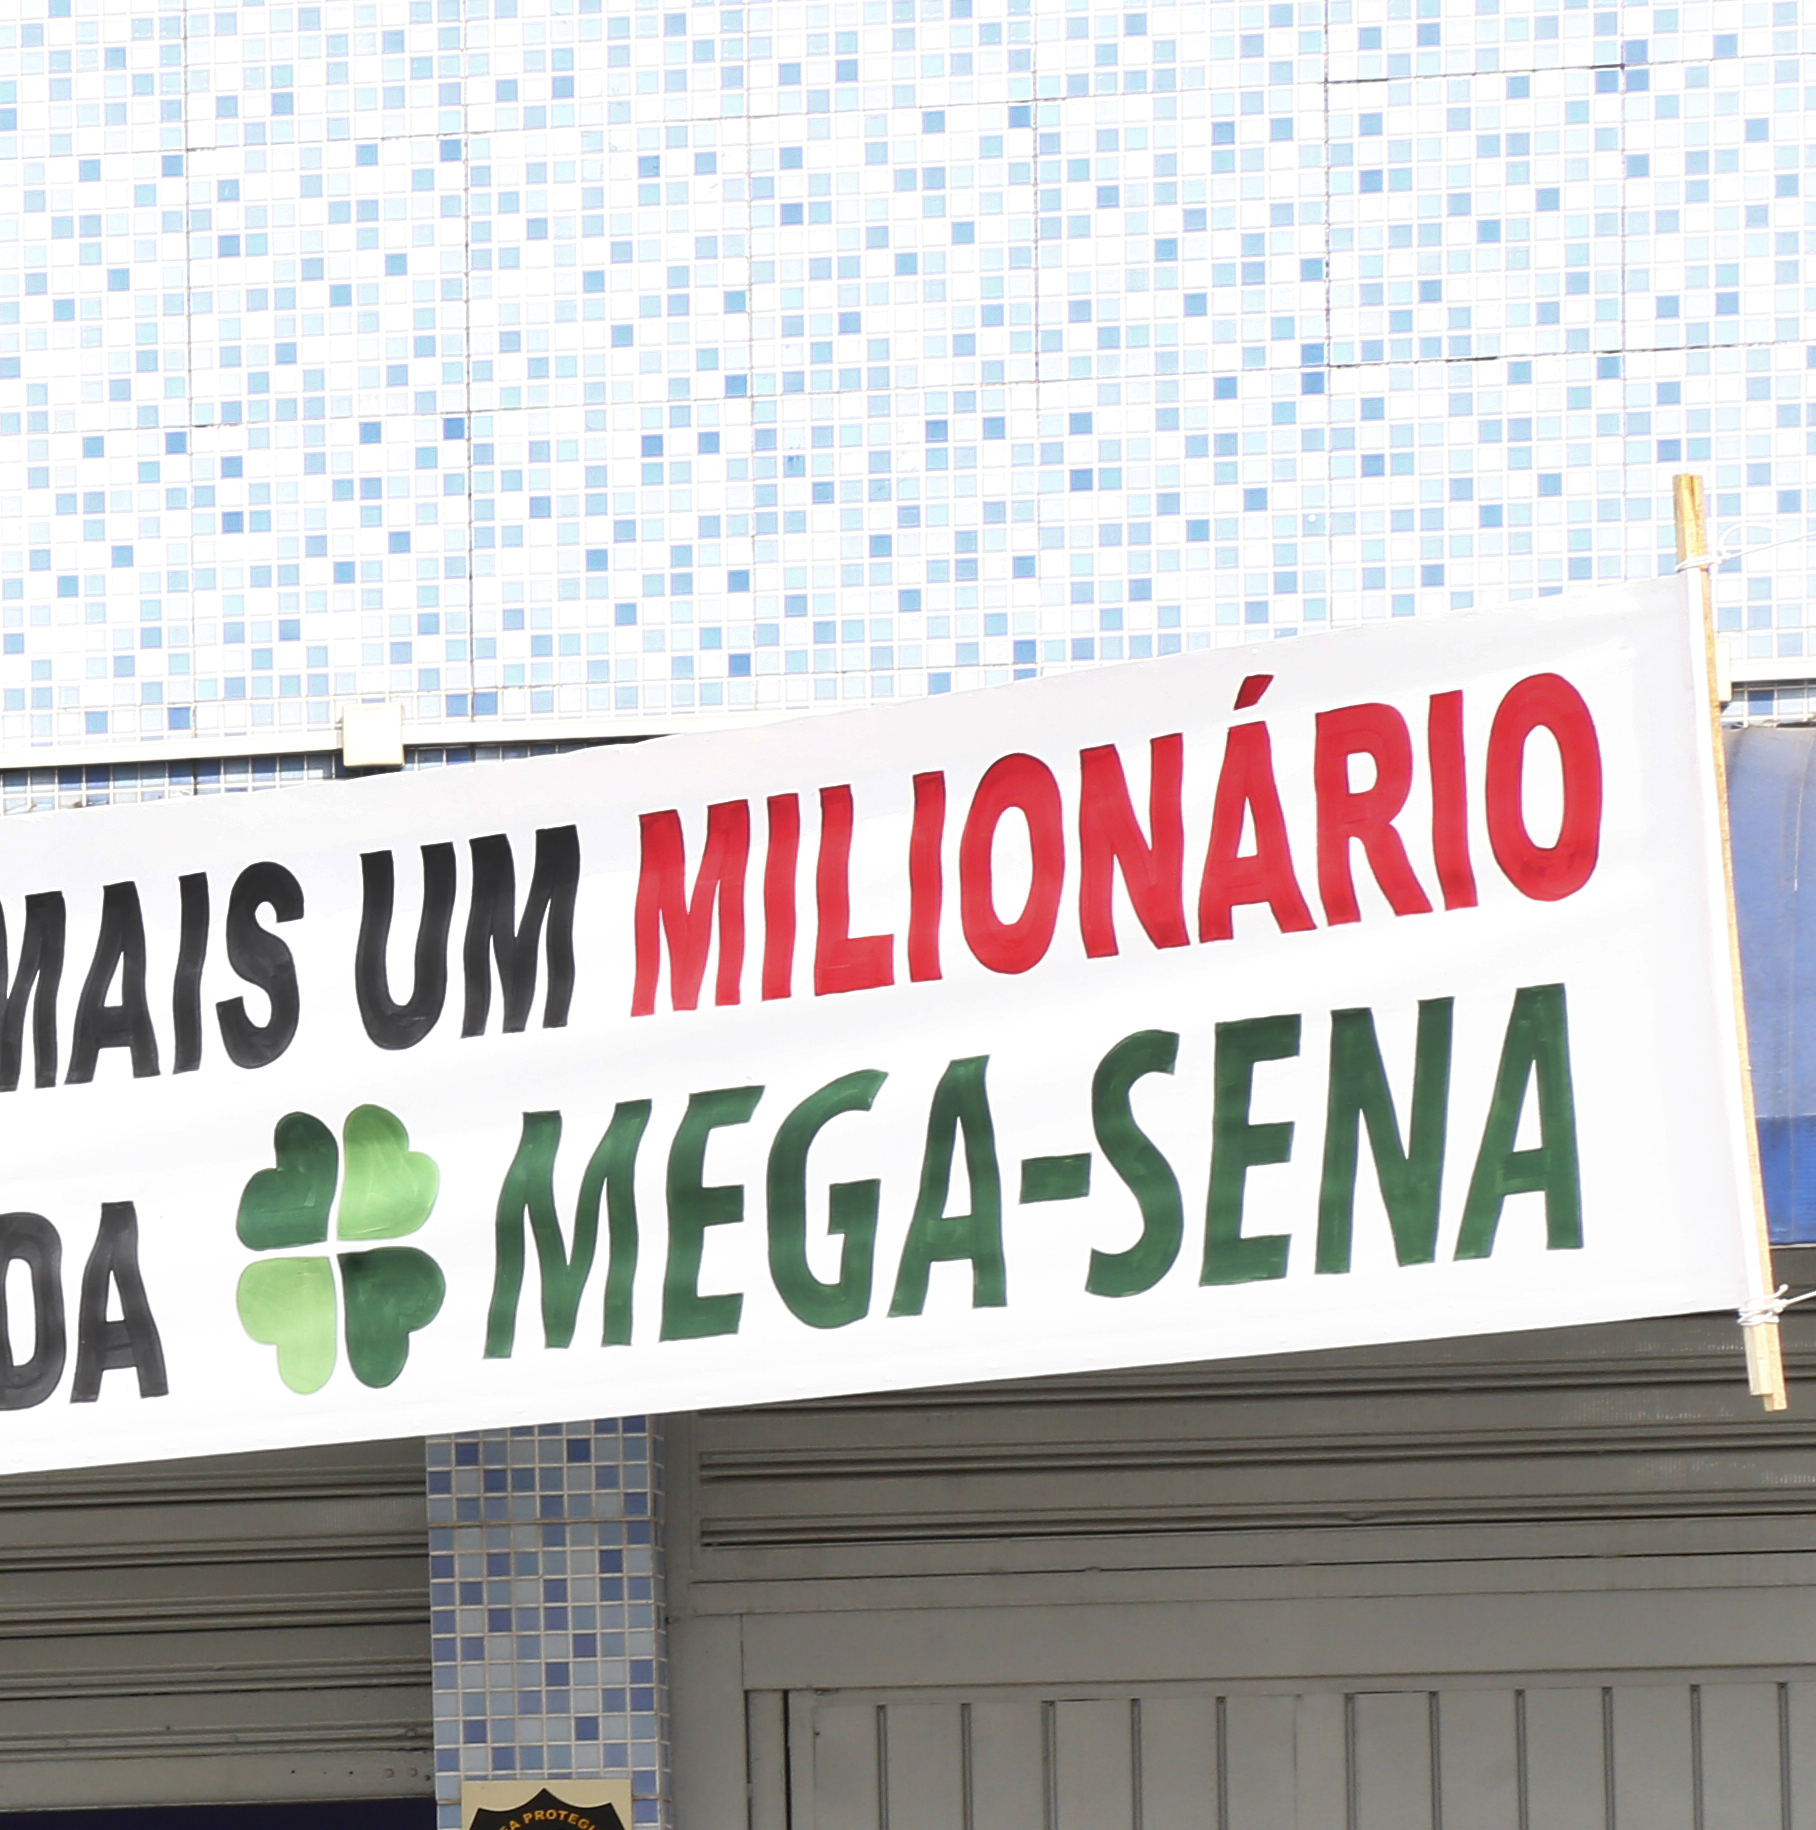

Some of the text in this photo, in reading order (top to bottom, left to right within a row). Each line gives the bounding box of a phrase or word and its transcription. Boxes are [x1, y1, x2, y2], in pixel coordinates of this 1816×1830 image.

[353, 824, 582, 1052] UM
[629, 671, 1605, 1018] MILIONÁRIO
[480, 979, 1587, 1358] MEGA-SENA
